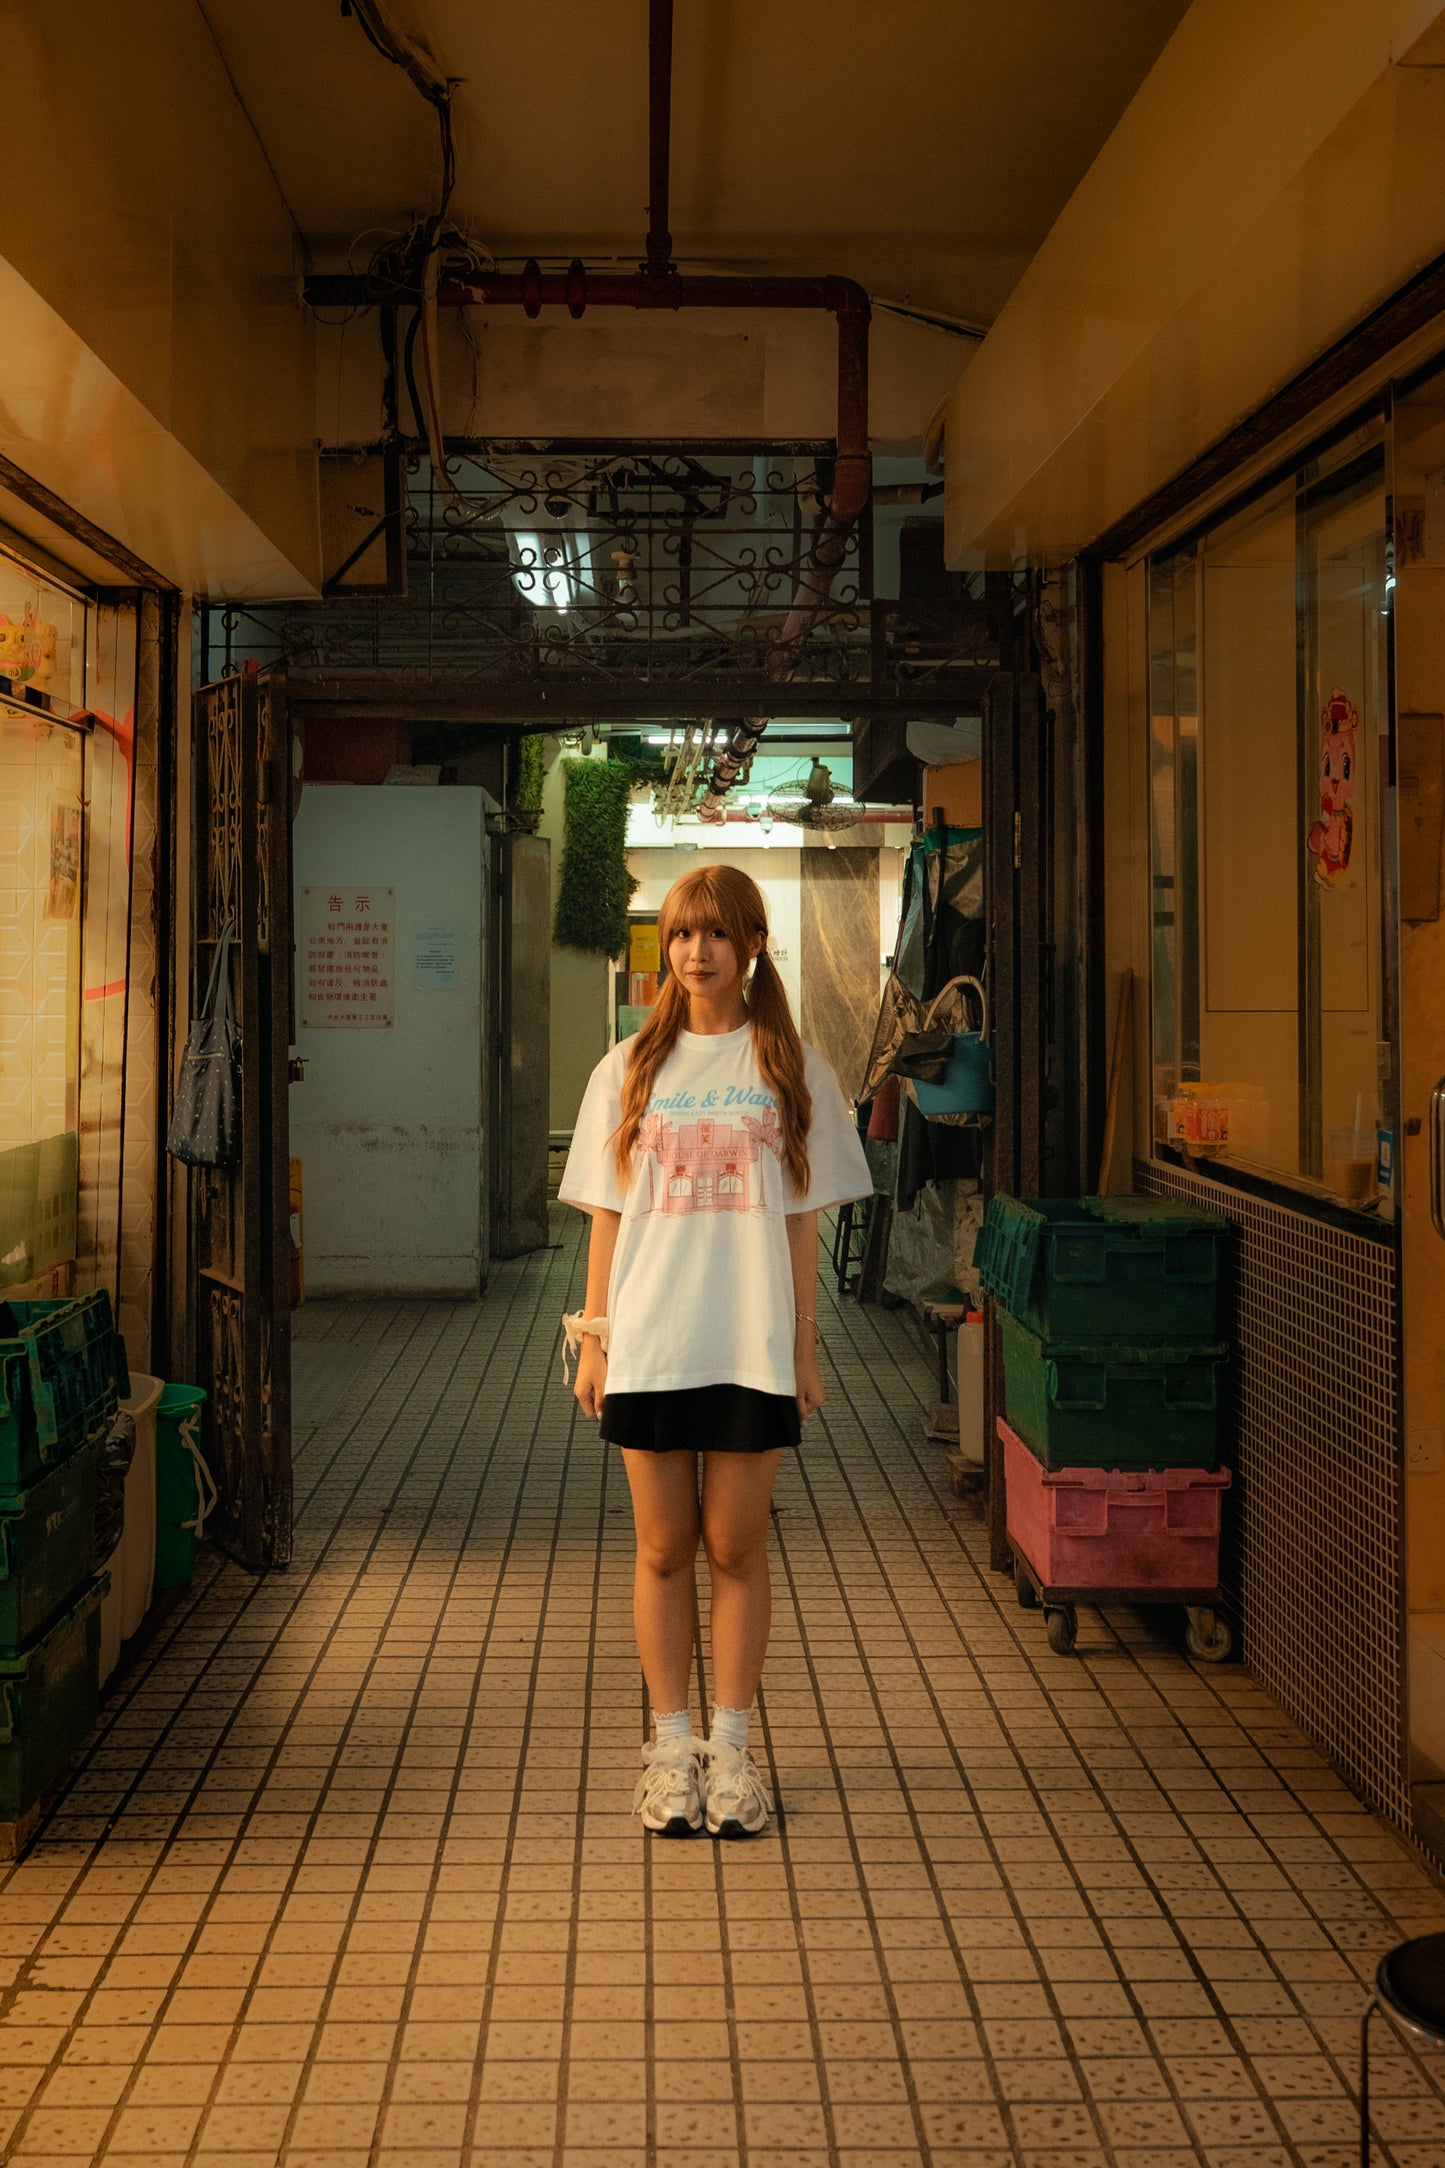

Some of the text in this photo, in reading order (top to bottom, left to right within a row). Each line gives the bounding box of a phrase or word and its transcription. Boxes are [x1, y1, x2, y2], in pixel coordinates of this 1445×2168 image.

[327, 895, 371, 912] 告示
[701, 1089, 719, 1108] &
[665, 1149, 748, 1160] HOUSE OF DARWIN
